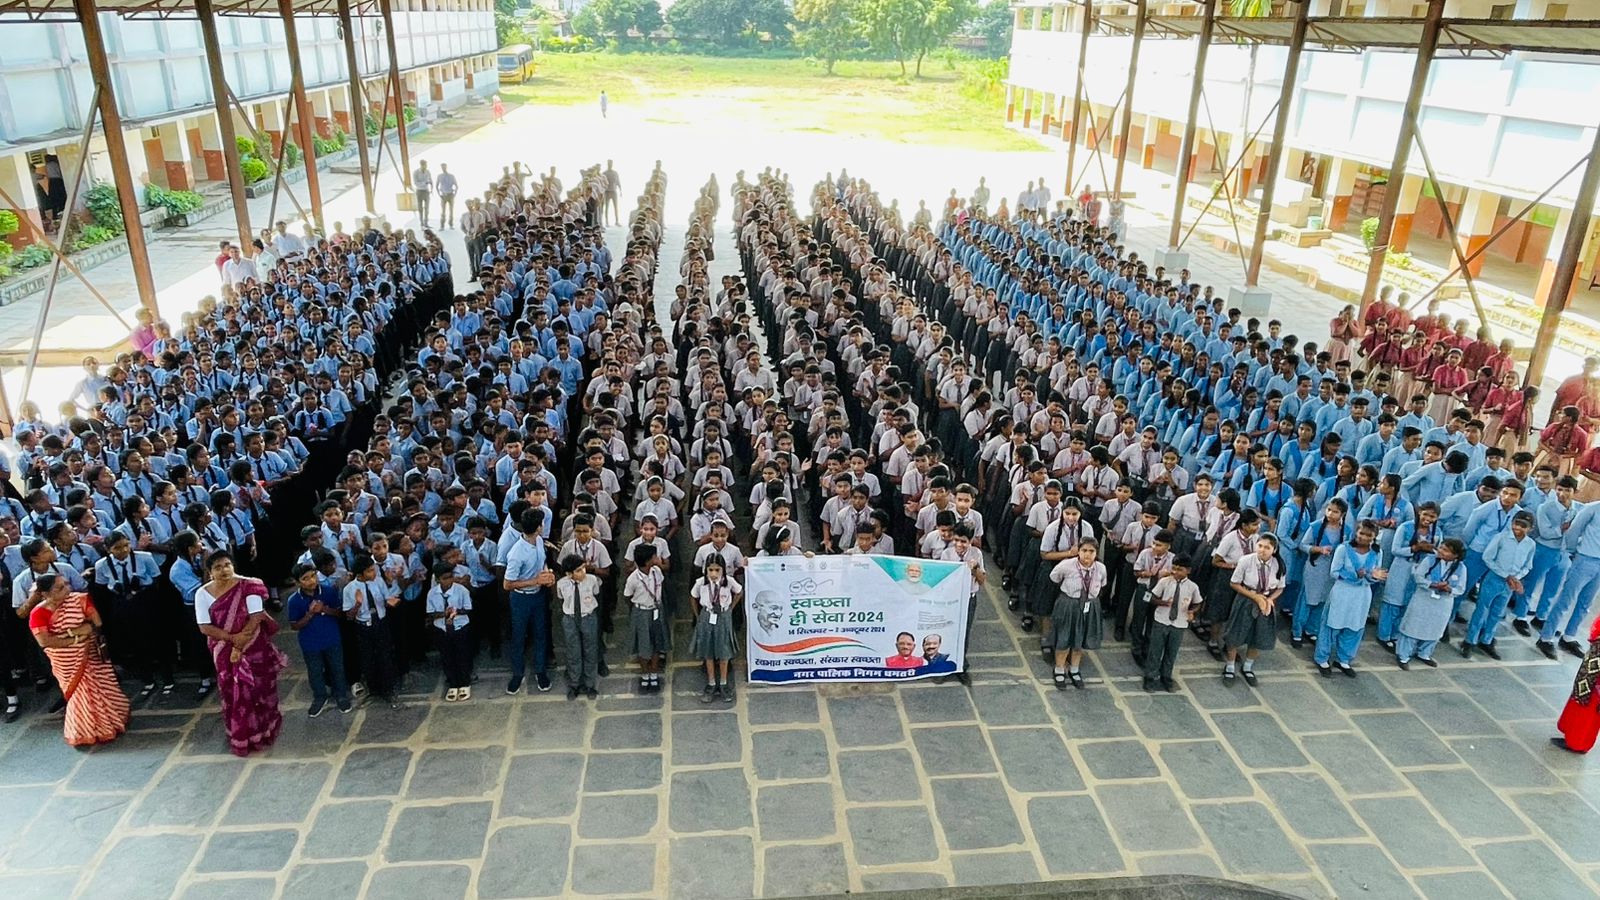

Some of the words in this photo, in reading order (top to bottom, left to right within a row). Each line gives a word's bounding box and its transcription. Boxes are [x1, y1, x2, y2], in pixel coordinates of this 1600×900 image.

[790, 597, 851, 609] स्वच्छता
[789, 610, 807, 626] ही
[812, 610, 845, 624] सेवा
[848, 611, 883, 622] 2024
[793, 670, 814, 678] नगर
[853, 668, 882, 677] निगम
